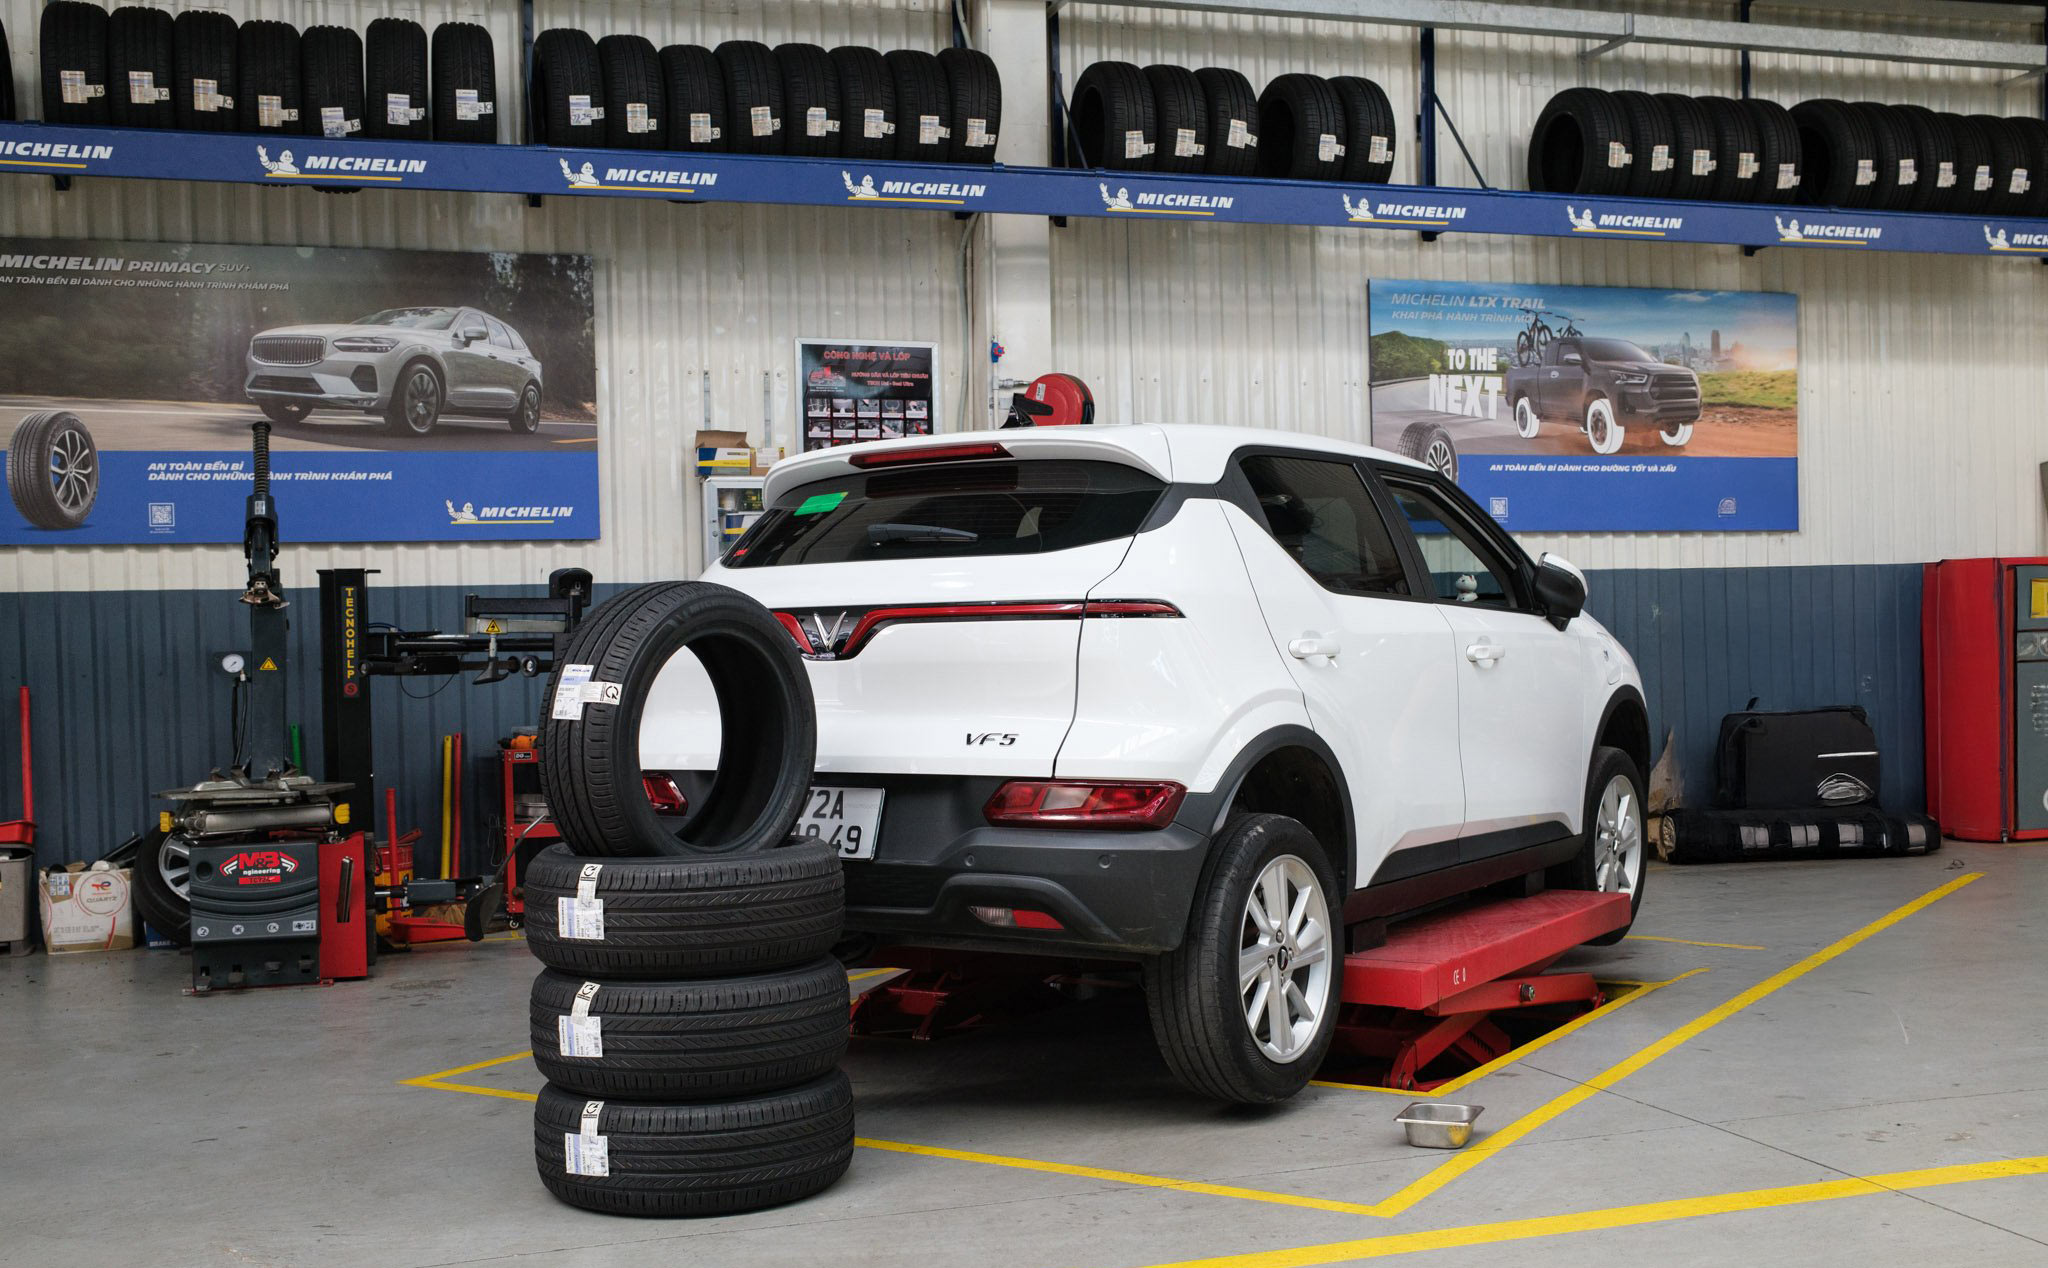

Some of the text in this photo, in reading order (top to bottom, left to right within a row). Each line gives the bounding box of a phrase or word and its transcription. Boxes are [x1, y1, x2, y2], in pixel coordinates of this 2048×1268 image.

[0, 141, 113, 159] ICHELIN
[305, 156, 427, 174] MICHELIN
[605, 168, 718, 186] MICHELIN
[881, 180, 986, 198] MICHELIN
[1136, 192, 1234, 210] MICHELIN
[1376, 203, 1467, 220] MICHELIN
[1598, 214, 1683, 230] MICHELIN
[1803, 224, 1883, 239] MICHELIN
[0, 254, 124, 271] MICHELIN
[127, 260, 217, 274] PRIMACY
[113, 279, 136, 288] CHO
[1391, 293, 1546, 310] MICHELIN LTX TRAIL
[1391, 311, 1420, 320] KHAI
[1447, 347, 1498, 371] TO THE
[1428, 373, 1503, 420] NEXT
[148, 462, 167, 471] AN
[169, 461, 202, 471] TOÀN
[1489, 464, 1503, 472] AN
[1504, 463, 1528, 472] TOÀN
[1582, 464, 1600, 472] CHO
[186, 472, 211, 481] CHO
[267, 471, 293, 481] ÀNH
[294, 471, 330, 481] TRÌNH
[331, 471, 366, 481] KHÁM
[368, 471, 393, 481] PHÁ
[480, 506, 574, 518] MICHELIN
[345, 587, 356, 679] TECNOHELP
